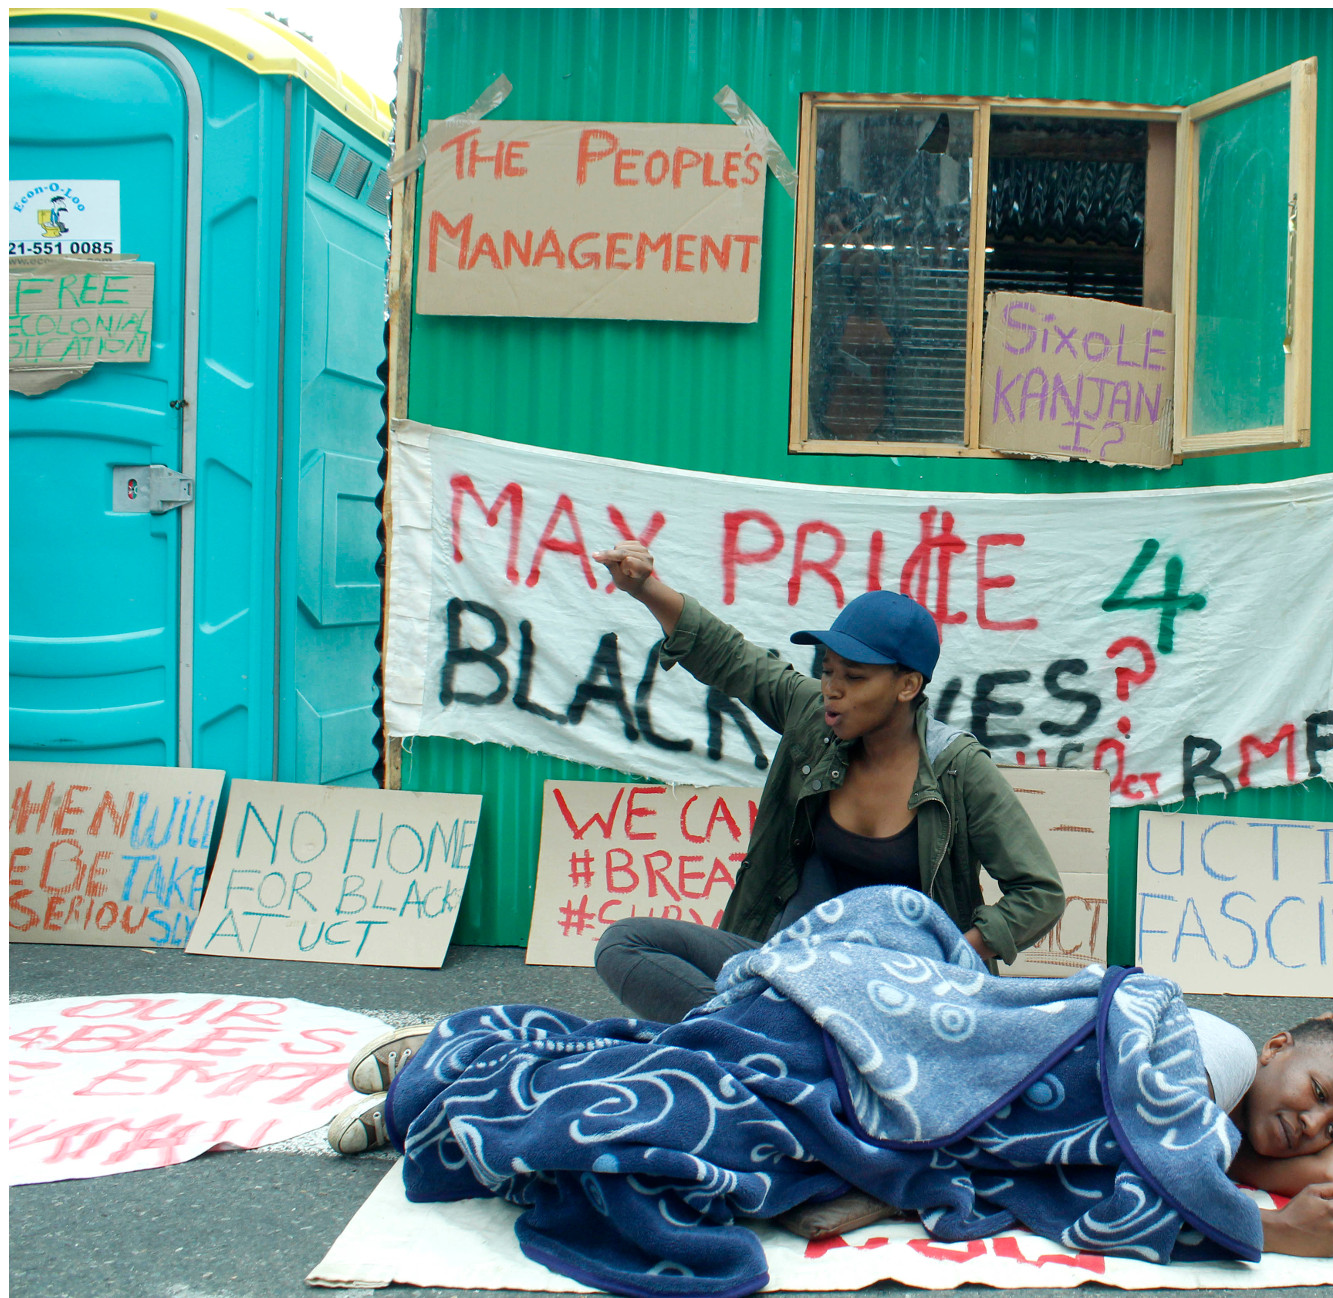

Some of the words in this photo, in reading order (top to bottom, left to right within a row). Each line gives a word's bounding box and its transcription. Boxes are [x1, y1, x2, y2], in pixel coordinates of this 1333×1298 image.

[440, 128, 530, 180] THE
[576, 128, 763, 189] PEOPLE'S
[13, 183, 86, 213] Econ-O-Loo
[9, 242, 62, 255] 21-551
[70, 242, 114, 255] 0085
[428, 210, 761, 273] MANAGEMENT
[16, 274, 134, 316] FREE
[9, 310, 149, 337] ECOLONIAL
[449, 473, 666, 594] MAX
[1101, 538, 1207, 654] 4
[236, 801, 327, 865] NO
[553, 786, 667, 841] WE
[40, 838, 113, 897] BE
[224, 867, 318, 914] FOR
[568, 847, 747, 902] #BREA
[204, 908, 290, 954] AT
[298, 920, 388, 958] UCT
[60, 998, 288, 1026] OUR
